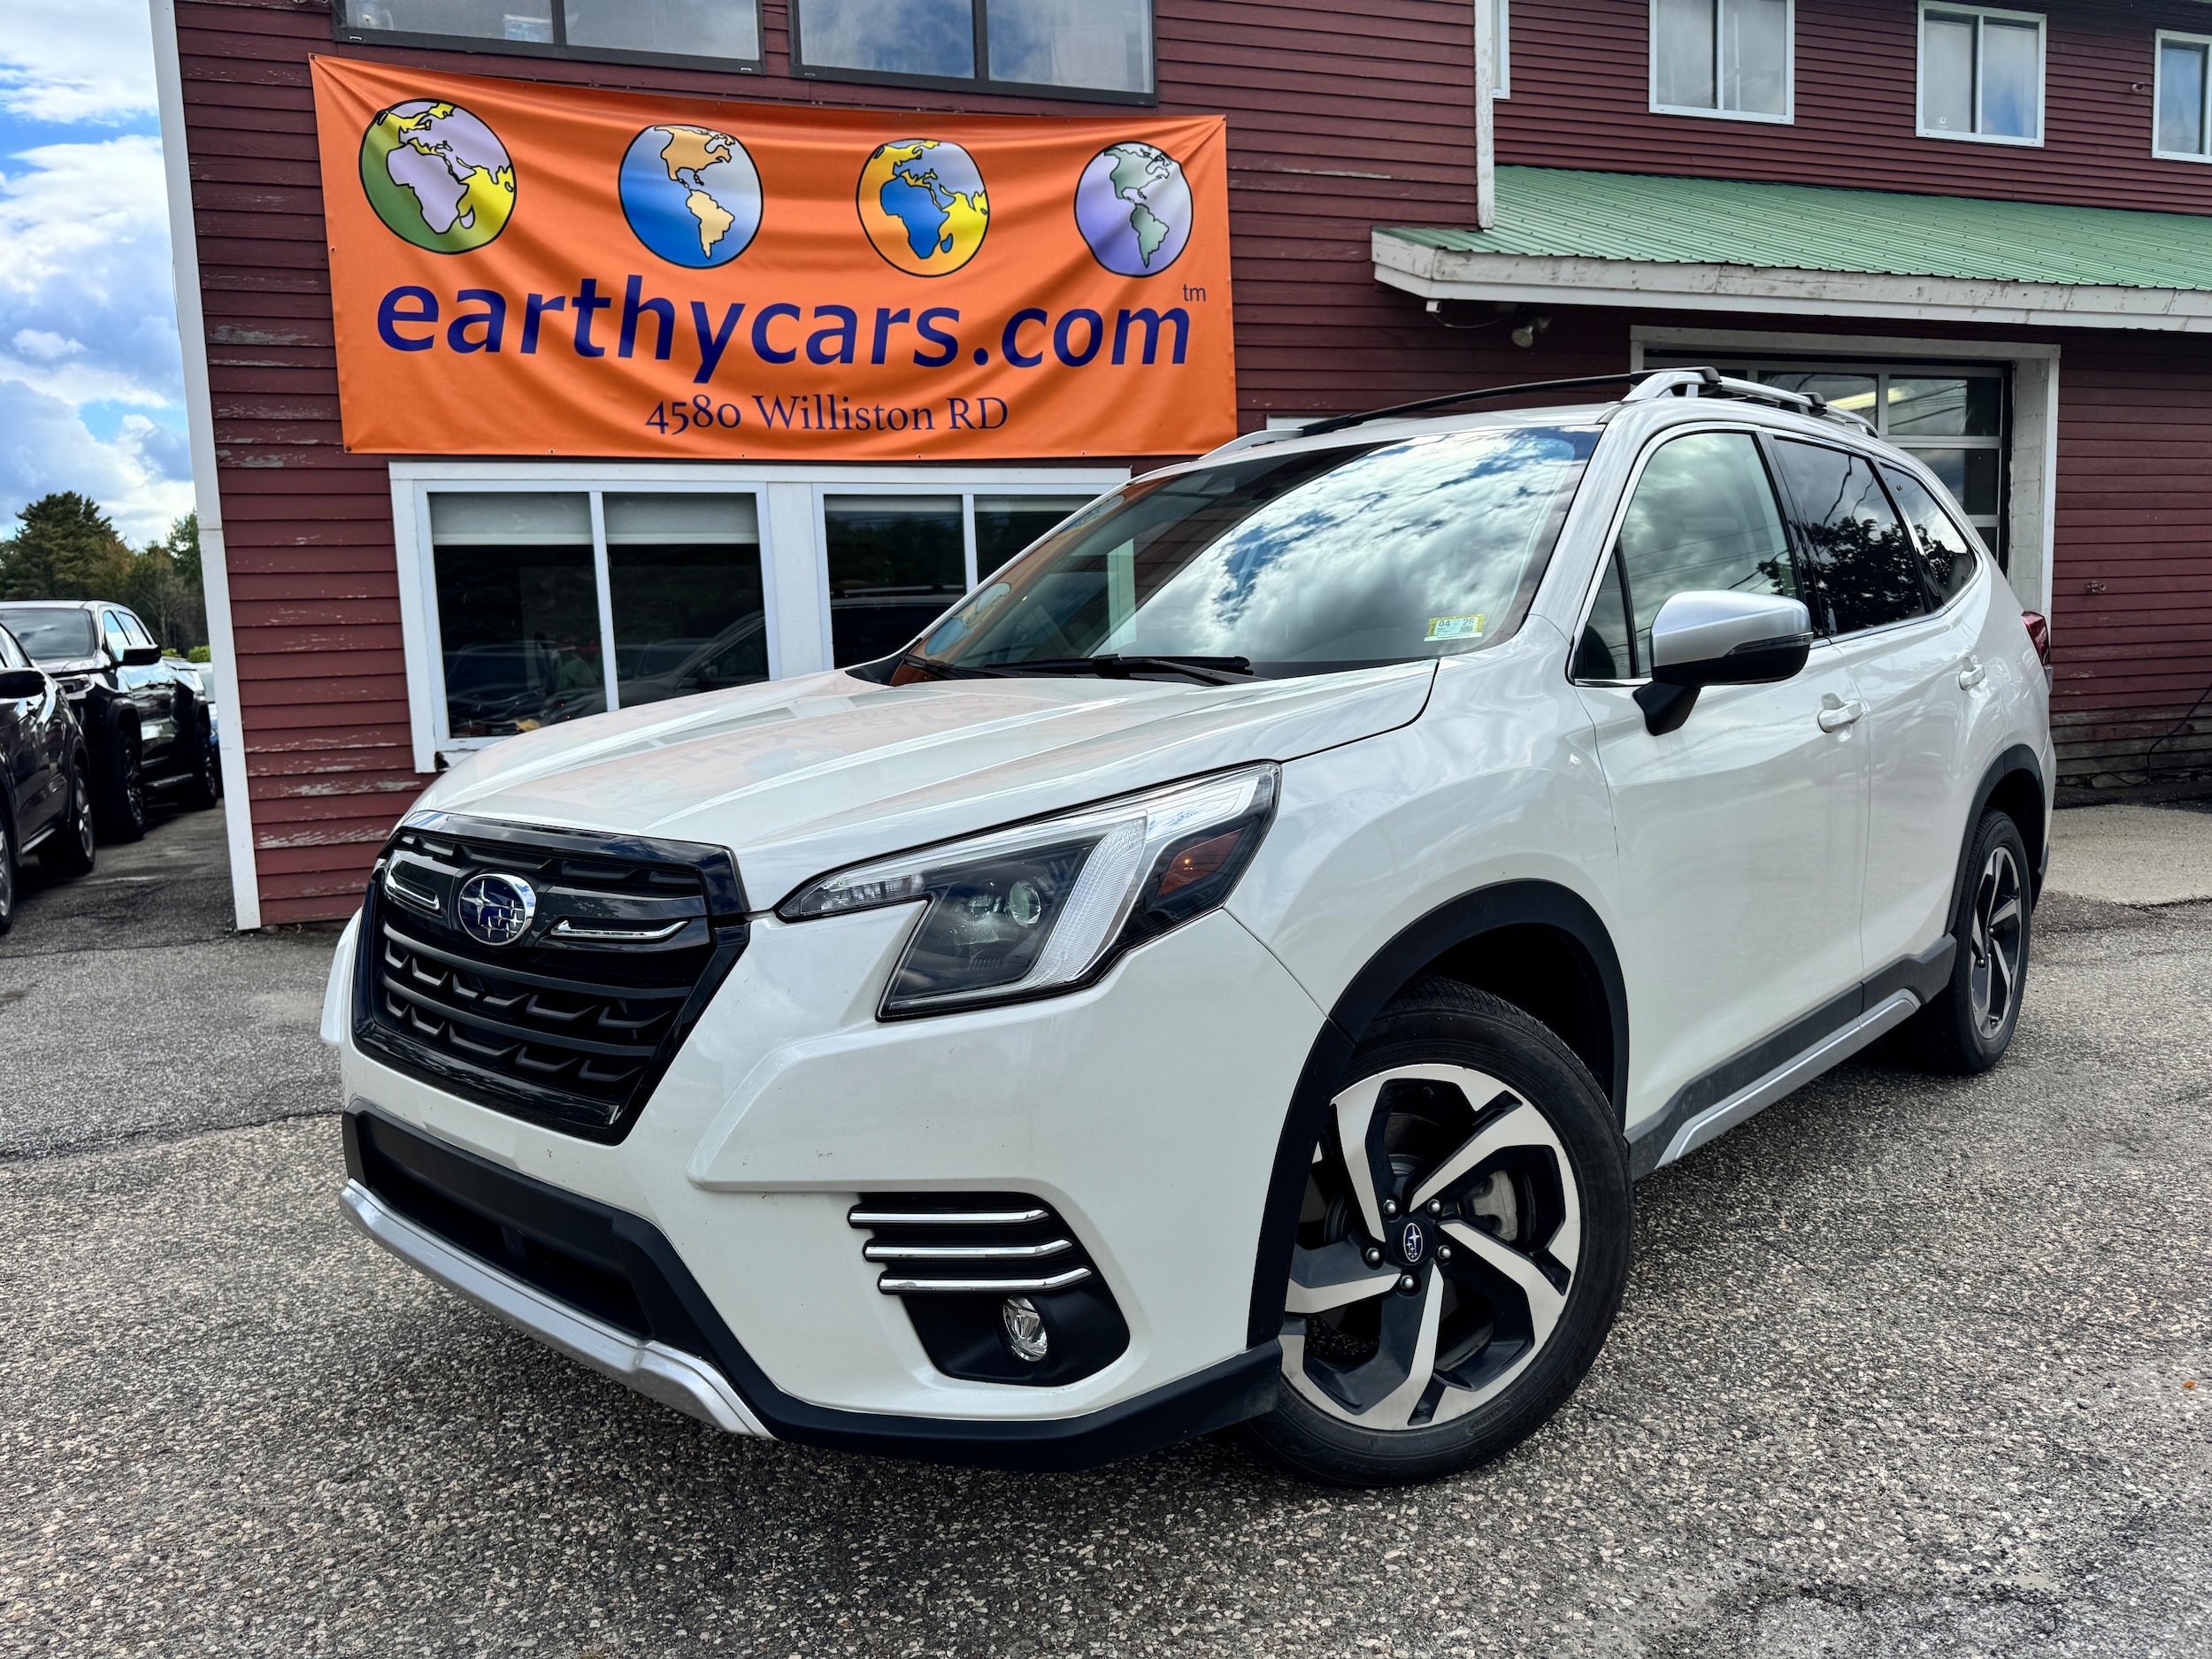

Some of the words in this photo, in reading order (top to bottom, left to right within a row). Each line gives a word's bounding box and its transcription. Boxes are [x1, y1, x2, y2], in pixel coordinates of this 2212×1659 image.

[377, 274, 1190, 385] earthycars.com
[1183, 284, 1207, 302] tm
[645, 394, 742, 434] 4580
[751, 394, 935, 431] Williston
[947, 396, 1009, 431] RD
